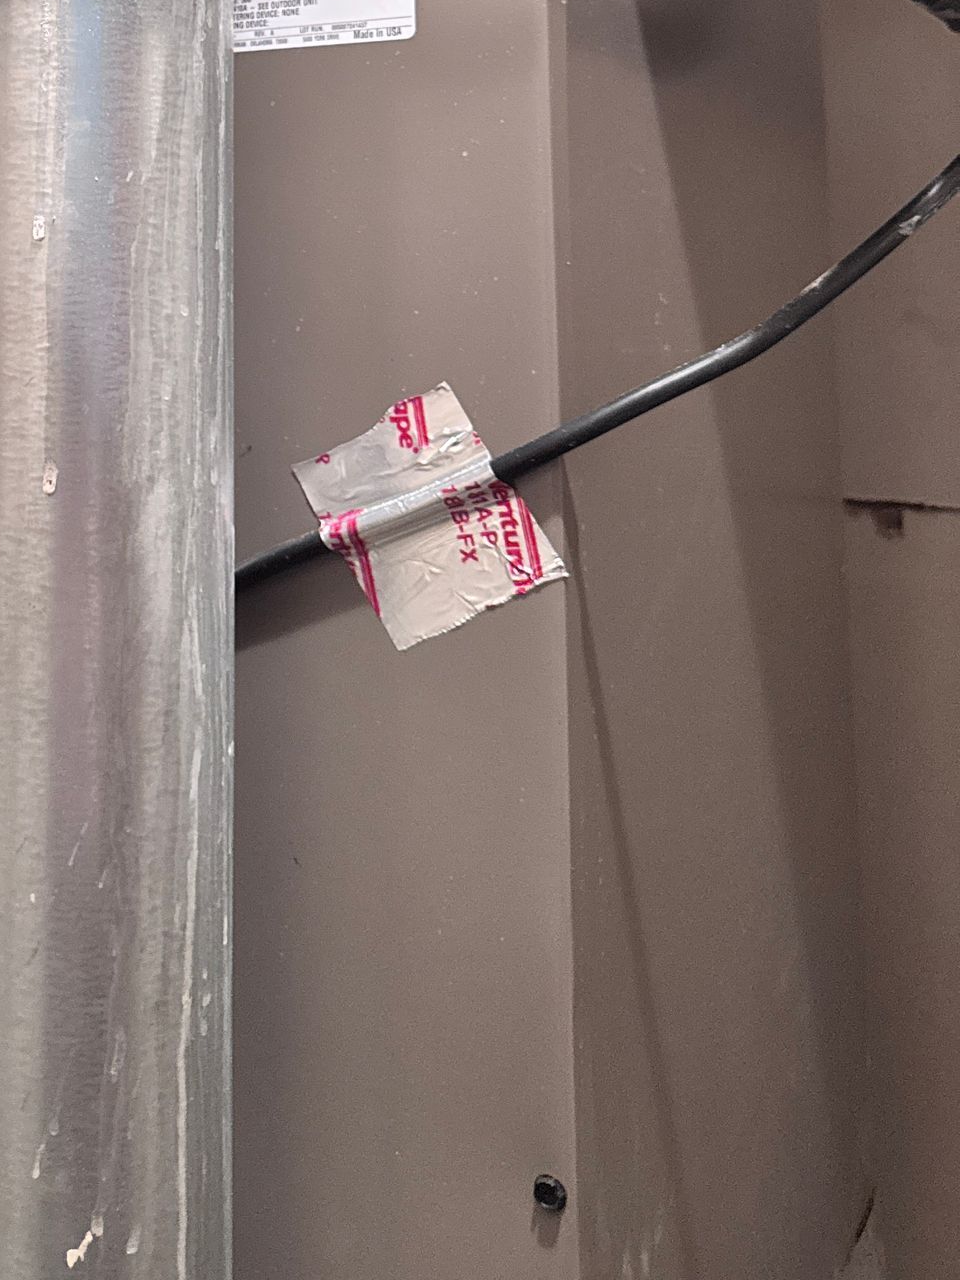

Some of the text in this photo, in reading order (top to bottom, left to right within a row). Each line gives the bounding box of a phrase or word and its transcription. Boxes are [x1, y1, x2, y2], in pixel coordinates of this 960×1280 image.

[257, 2, 270, 11] SEE
[282, 8, 300, 17] NONE
[353, 28, 374, 40] Made
[386, 26, 402, 37] USA
